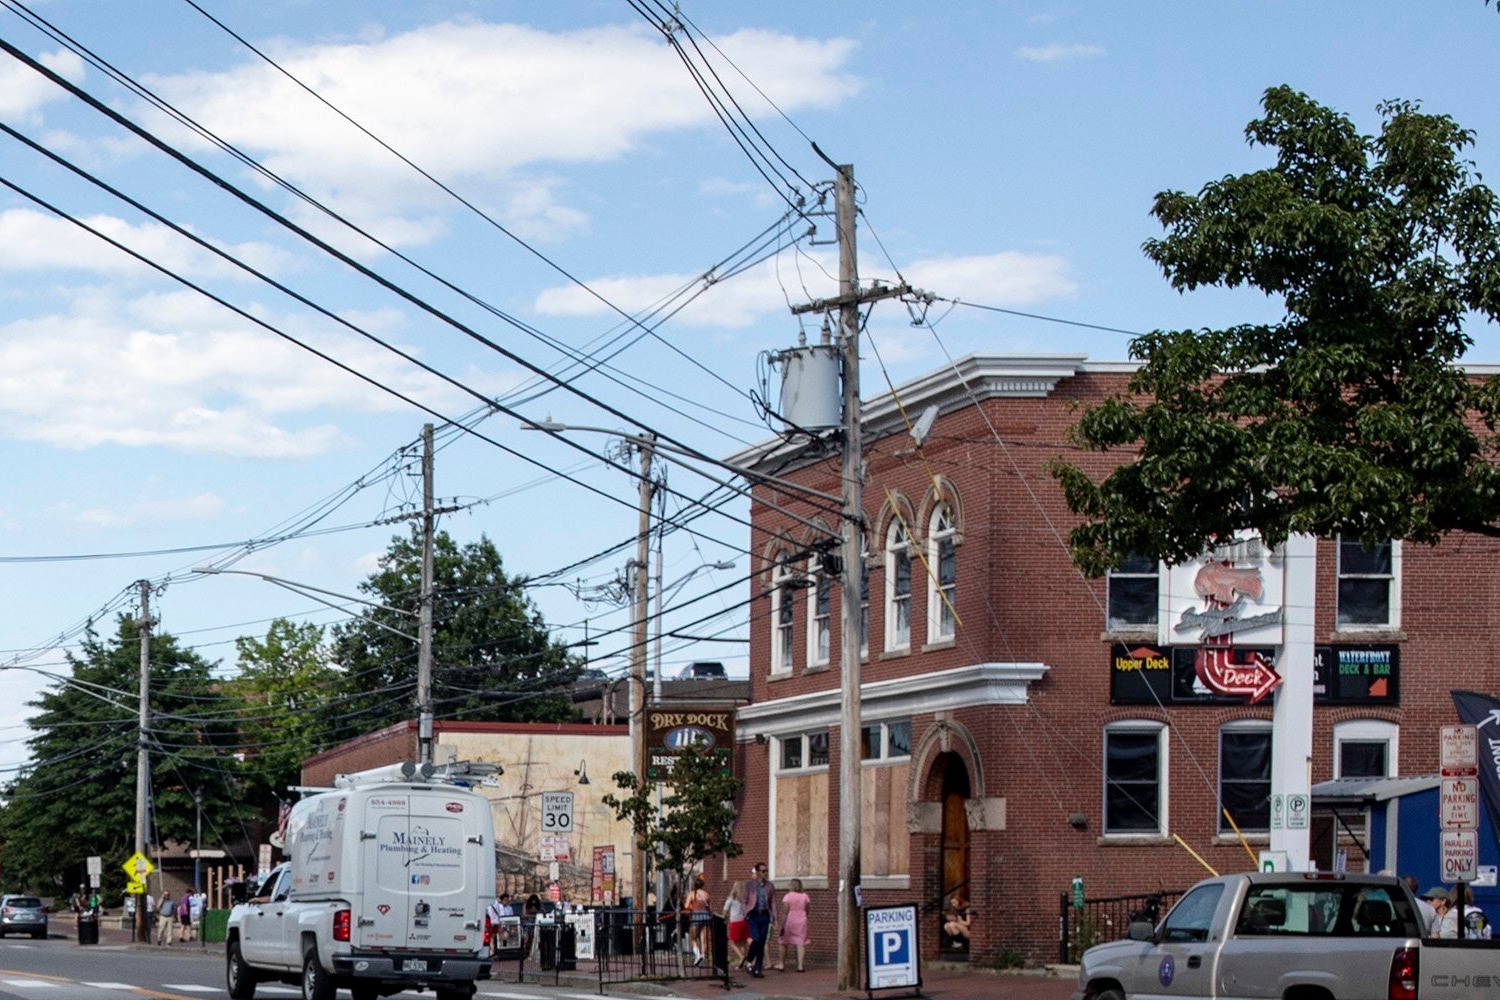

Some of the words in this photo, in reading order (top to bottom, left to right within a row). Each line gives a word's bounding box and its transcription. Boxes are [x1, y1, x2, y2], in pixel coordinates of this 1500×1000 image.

[1339, 650, 1391, 663] WATERFRONT
[1116, 658, 1143, 671] Upper
[1146, 657, 1169, 669] Deck
[1339, 664, 1360, 675] DECK
[1363, 664, 1370, 675] &
[1373, 664, 1390, 675] BAR
[1223, 668, 1263, 685] Deck
[650, 713, 686, 731] DRY
[686, 713, 729, 731] DOCK
[1452, 783, 1466, 792] NO
[1443, 794, 1476, 804] PARKING
[545, 813, 570, 827] 30
[393, 832, 446, 846] MAINELY
[380, 844, 419, 854] Plumbing
[430, 846, 462, 855] Heating
[1444, 849, 1474, 857] PARKING
[1445, 858, 1473, 872] ONLY
[868, 909, 913, 924] PARKING
[882, 932, 902, 964] P
